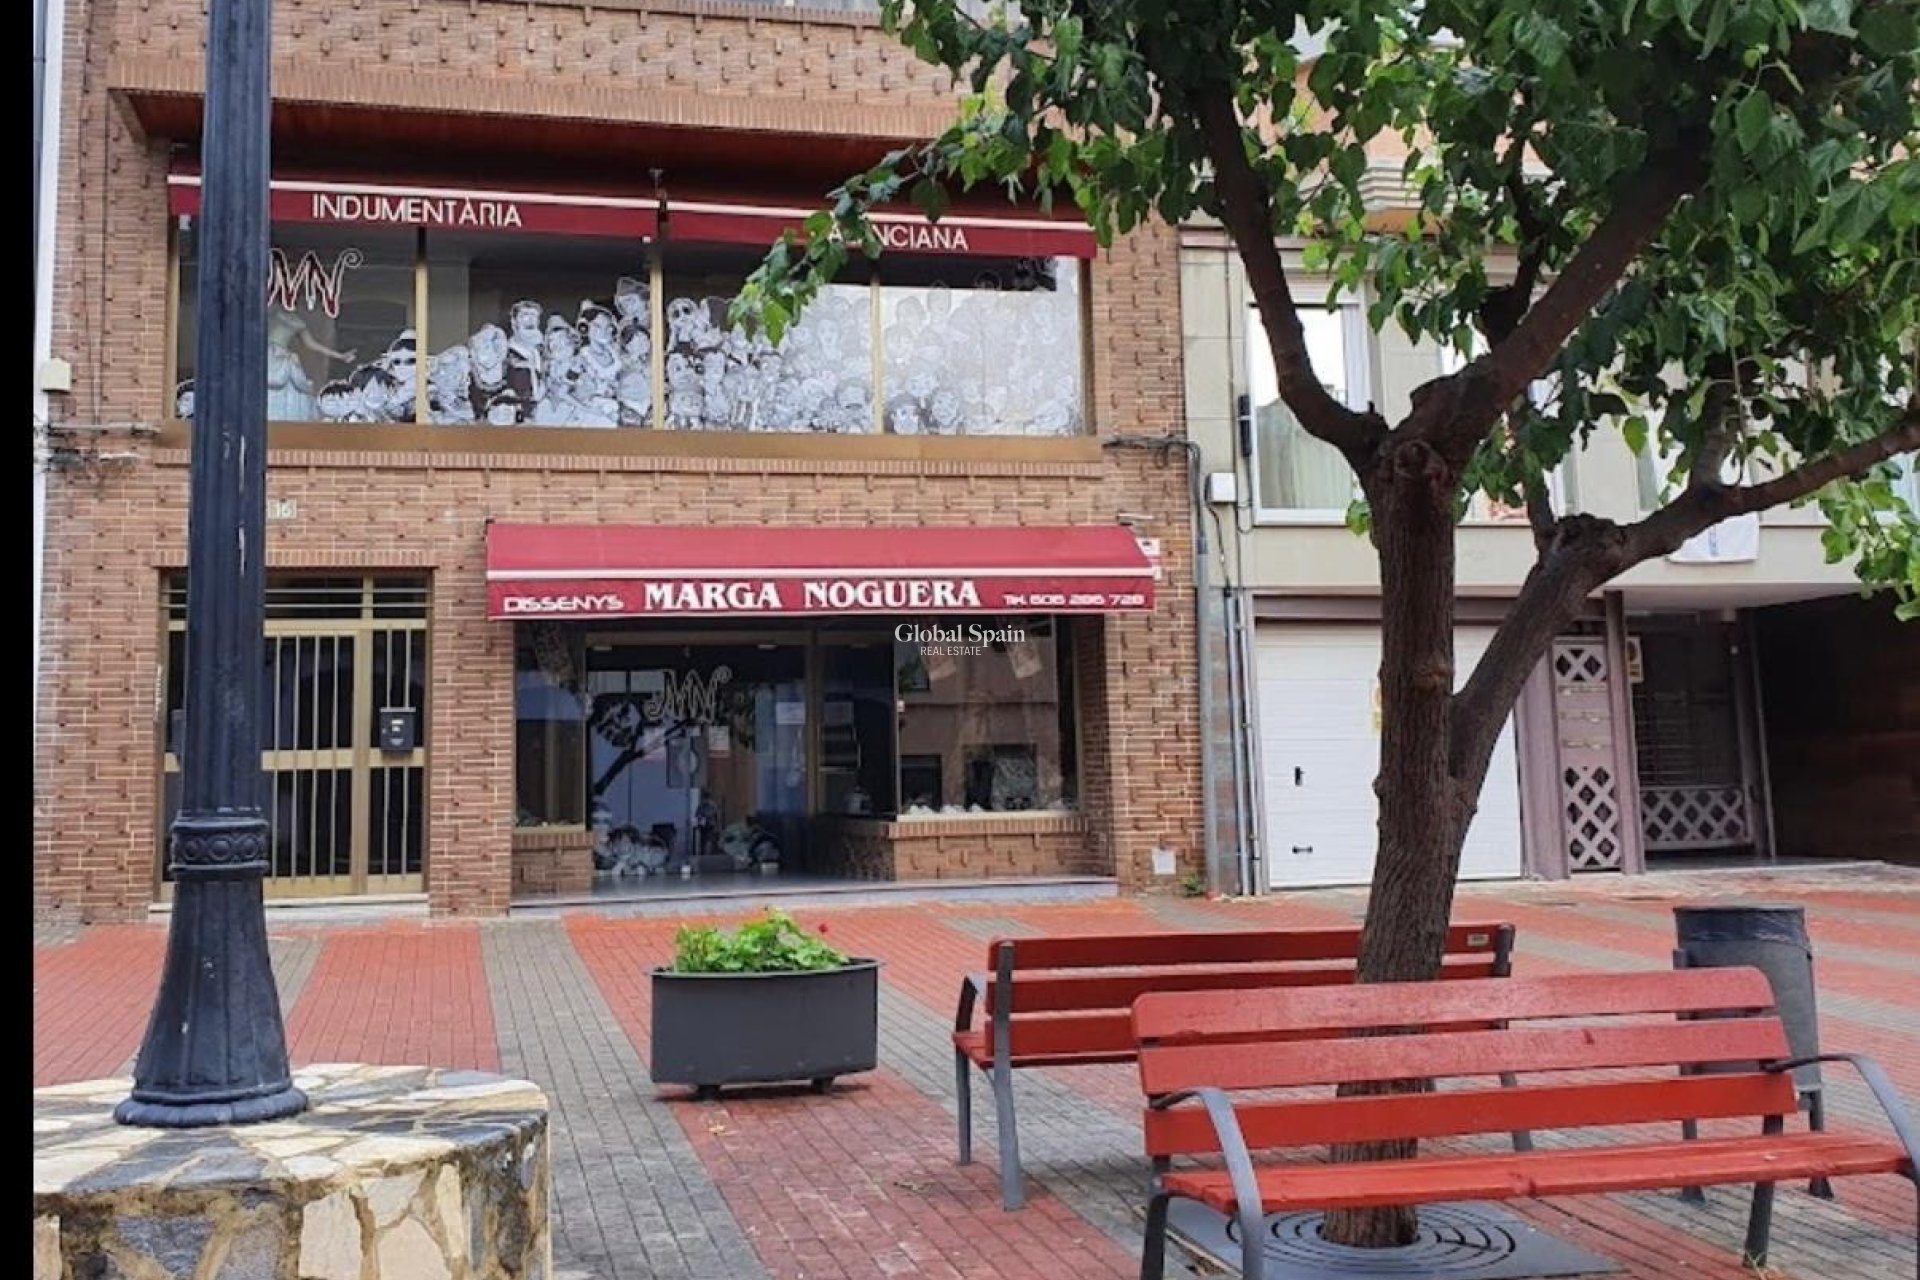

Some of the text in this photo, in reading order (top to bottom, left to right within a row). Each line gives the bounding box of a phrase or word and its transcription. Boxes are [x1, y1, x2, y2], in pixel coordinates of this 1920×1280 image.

[312, 193, 522, 227] INDUMENTÀRIA
[504, 595, 624, 612] DISSENYS
[644, 582, 782, 610] MARGA
[803, 580, 981, 608] NOGUERA
